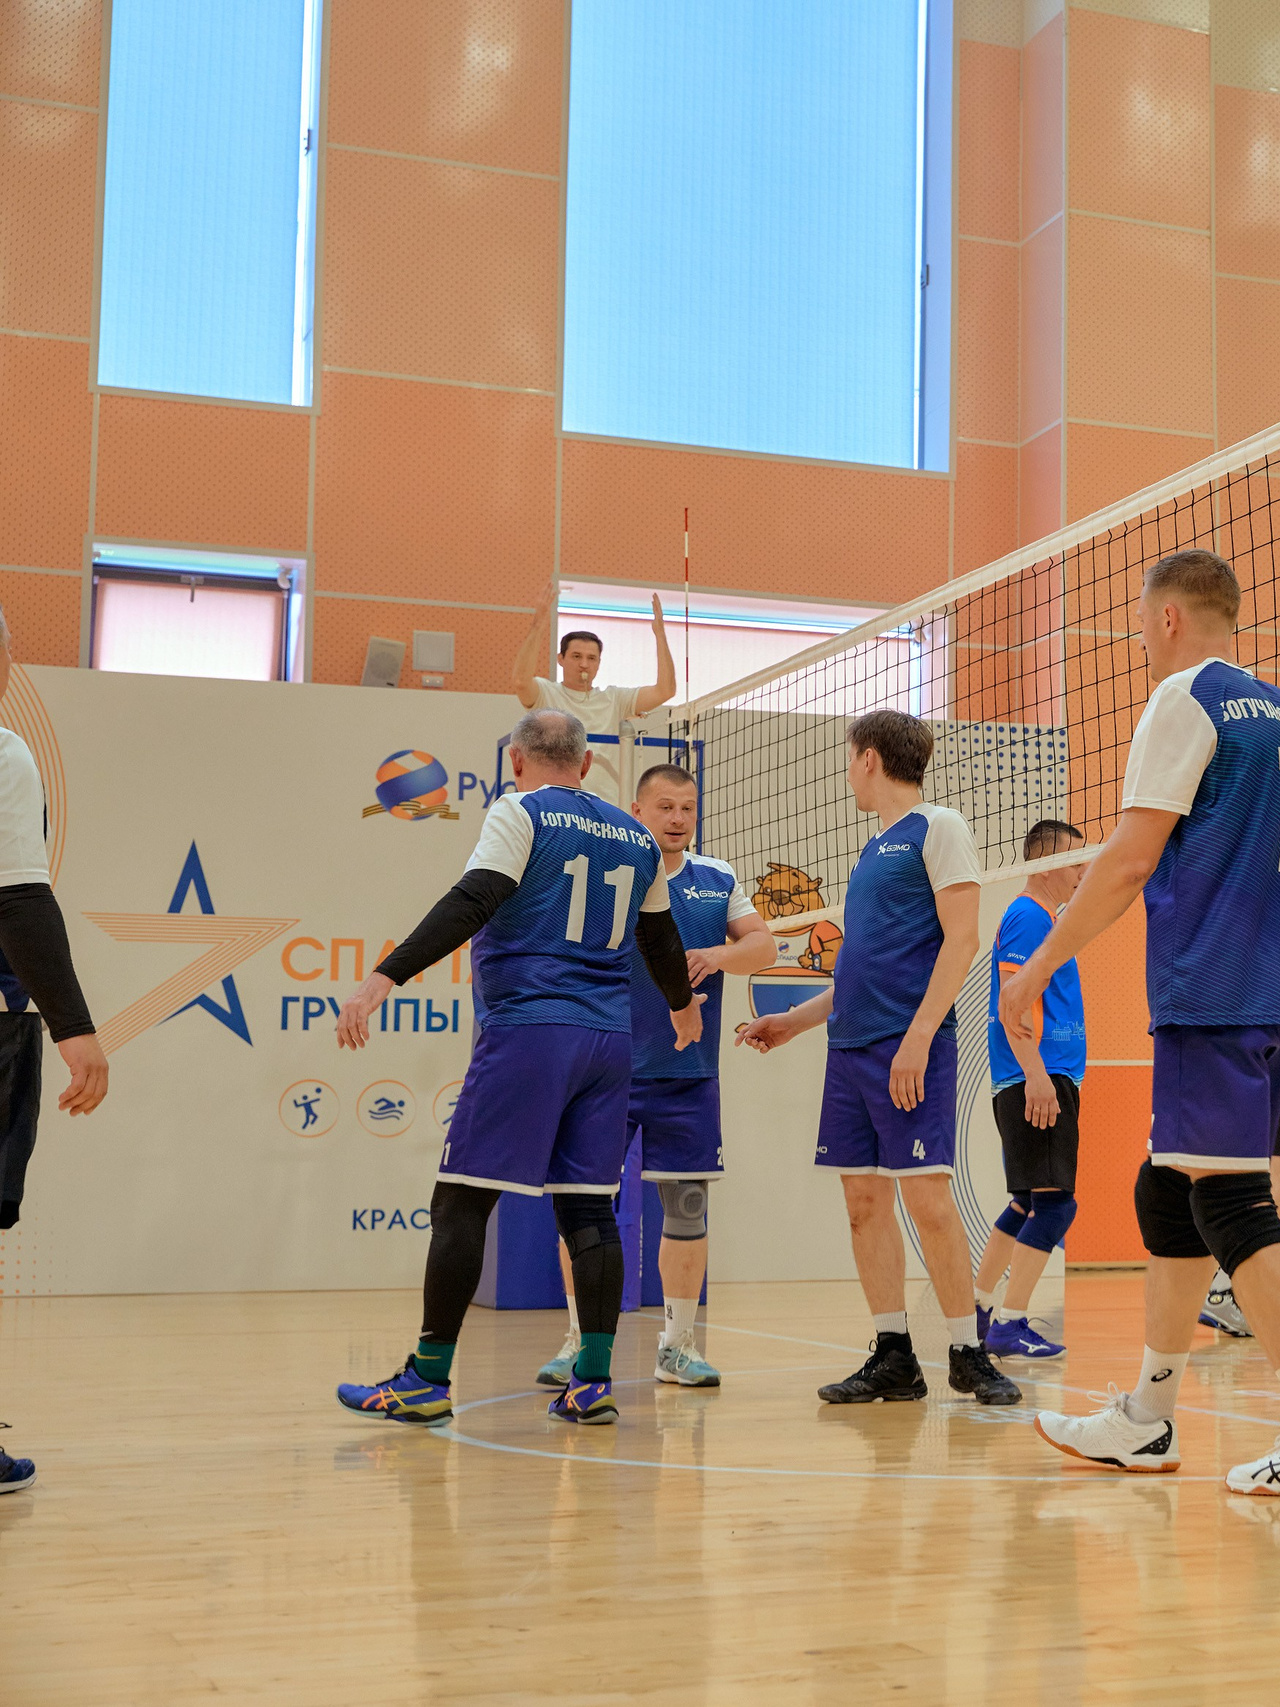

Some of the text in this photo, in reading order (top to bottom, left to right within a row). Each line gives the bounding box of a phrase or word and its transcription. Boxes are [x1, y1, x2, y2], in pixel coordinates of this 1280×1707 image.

[628, 829, 652, 850] ГЭС
[563, 853, 635, 950] 11
[912, 1138, 926, 1161] 4
